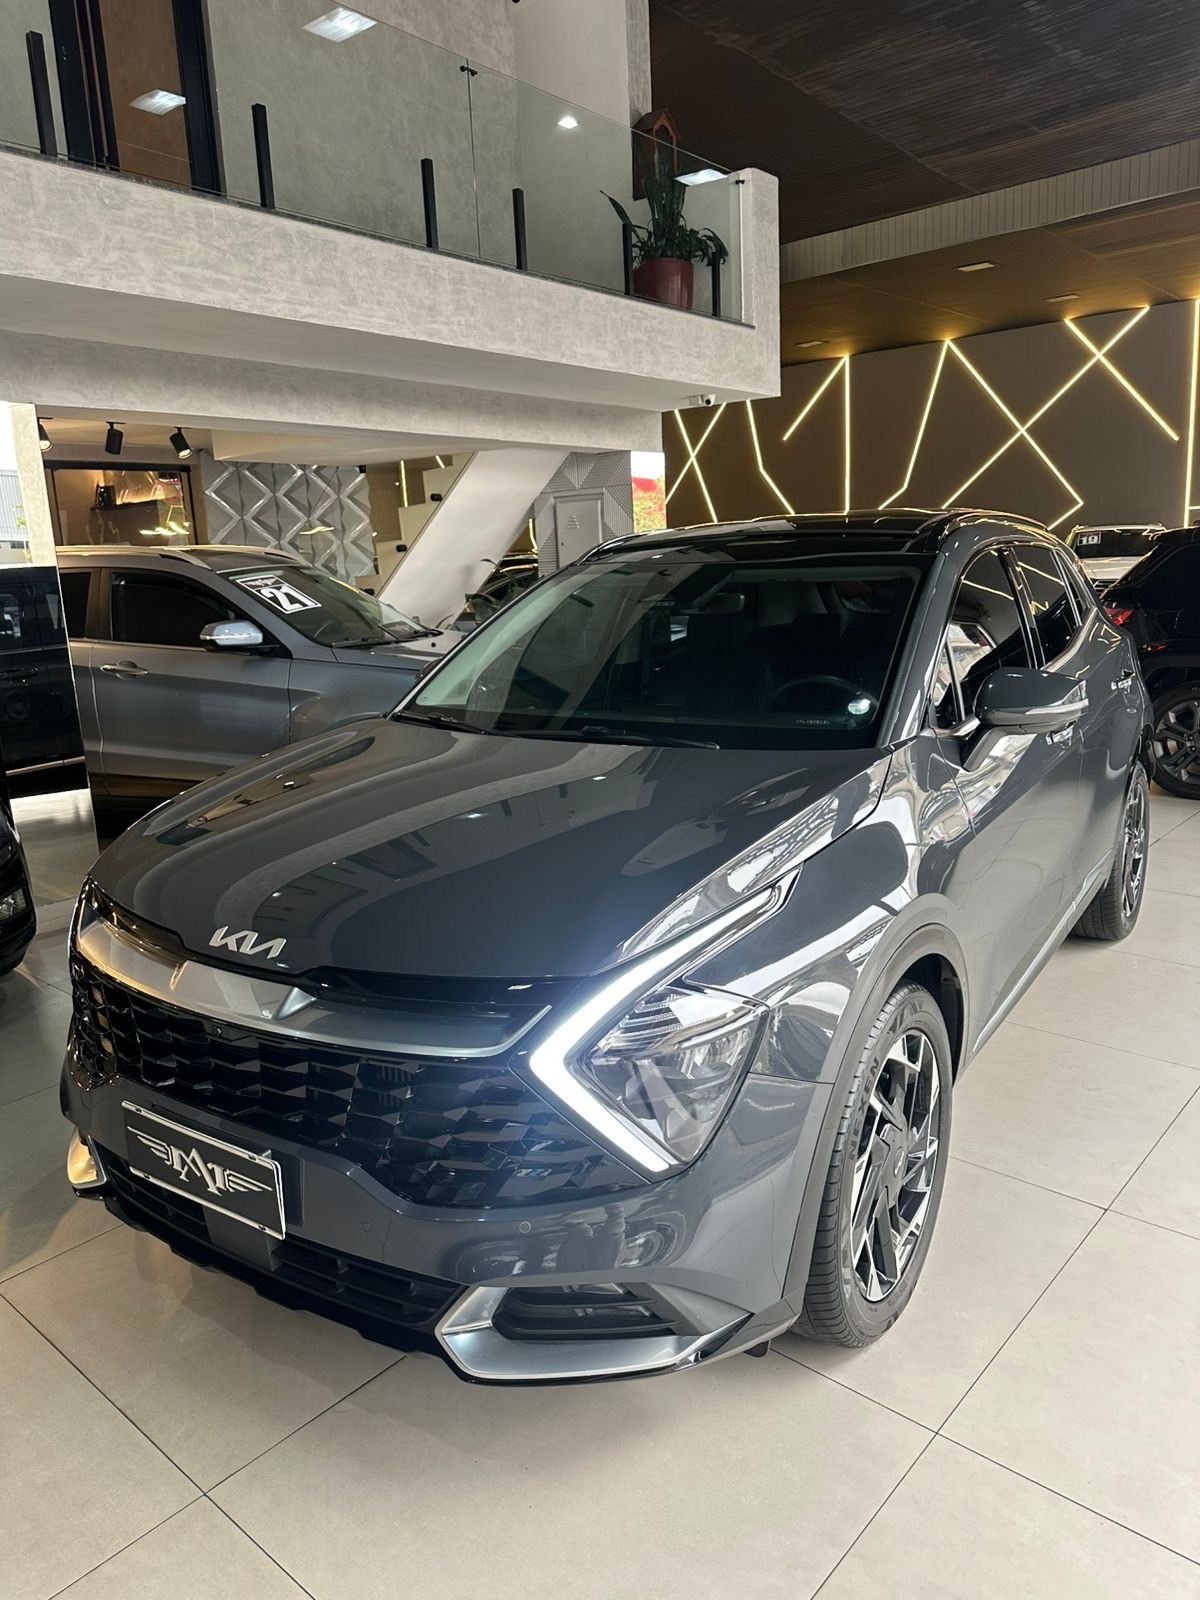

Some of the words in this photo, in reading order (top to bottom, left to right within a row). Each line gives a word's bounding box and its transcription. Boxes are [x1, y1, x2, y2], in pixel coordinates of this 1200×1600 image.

[1080, 535, 1099, 545] 19
[260, 585, 316, 611] 21
[209, 926, 287, 959] KIA
[849, 1057, 880, 1160] NEXEN
